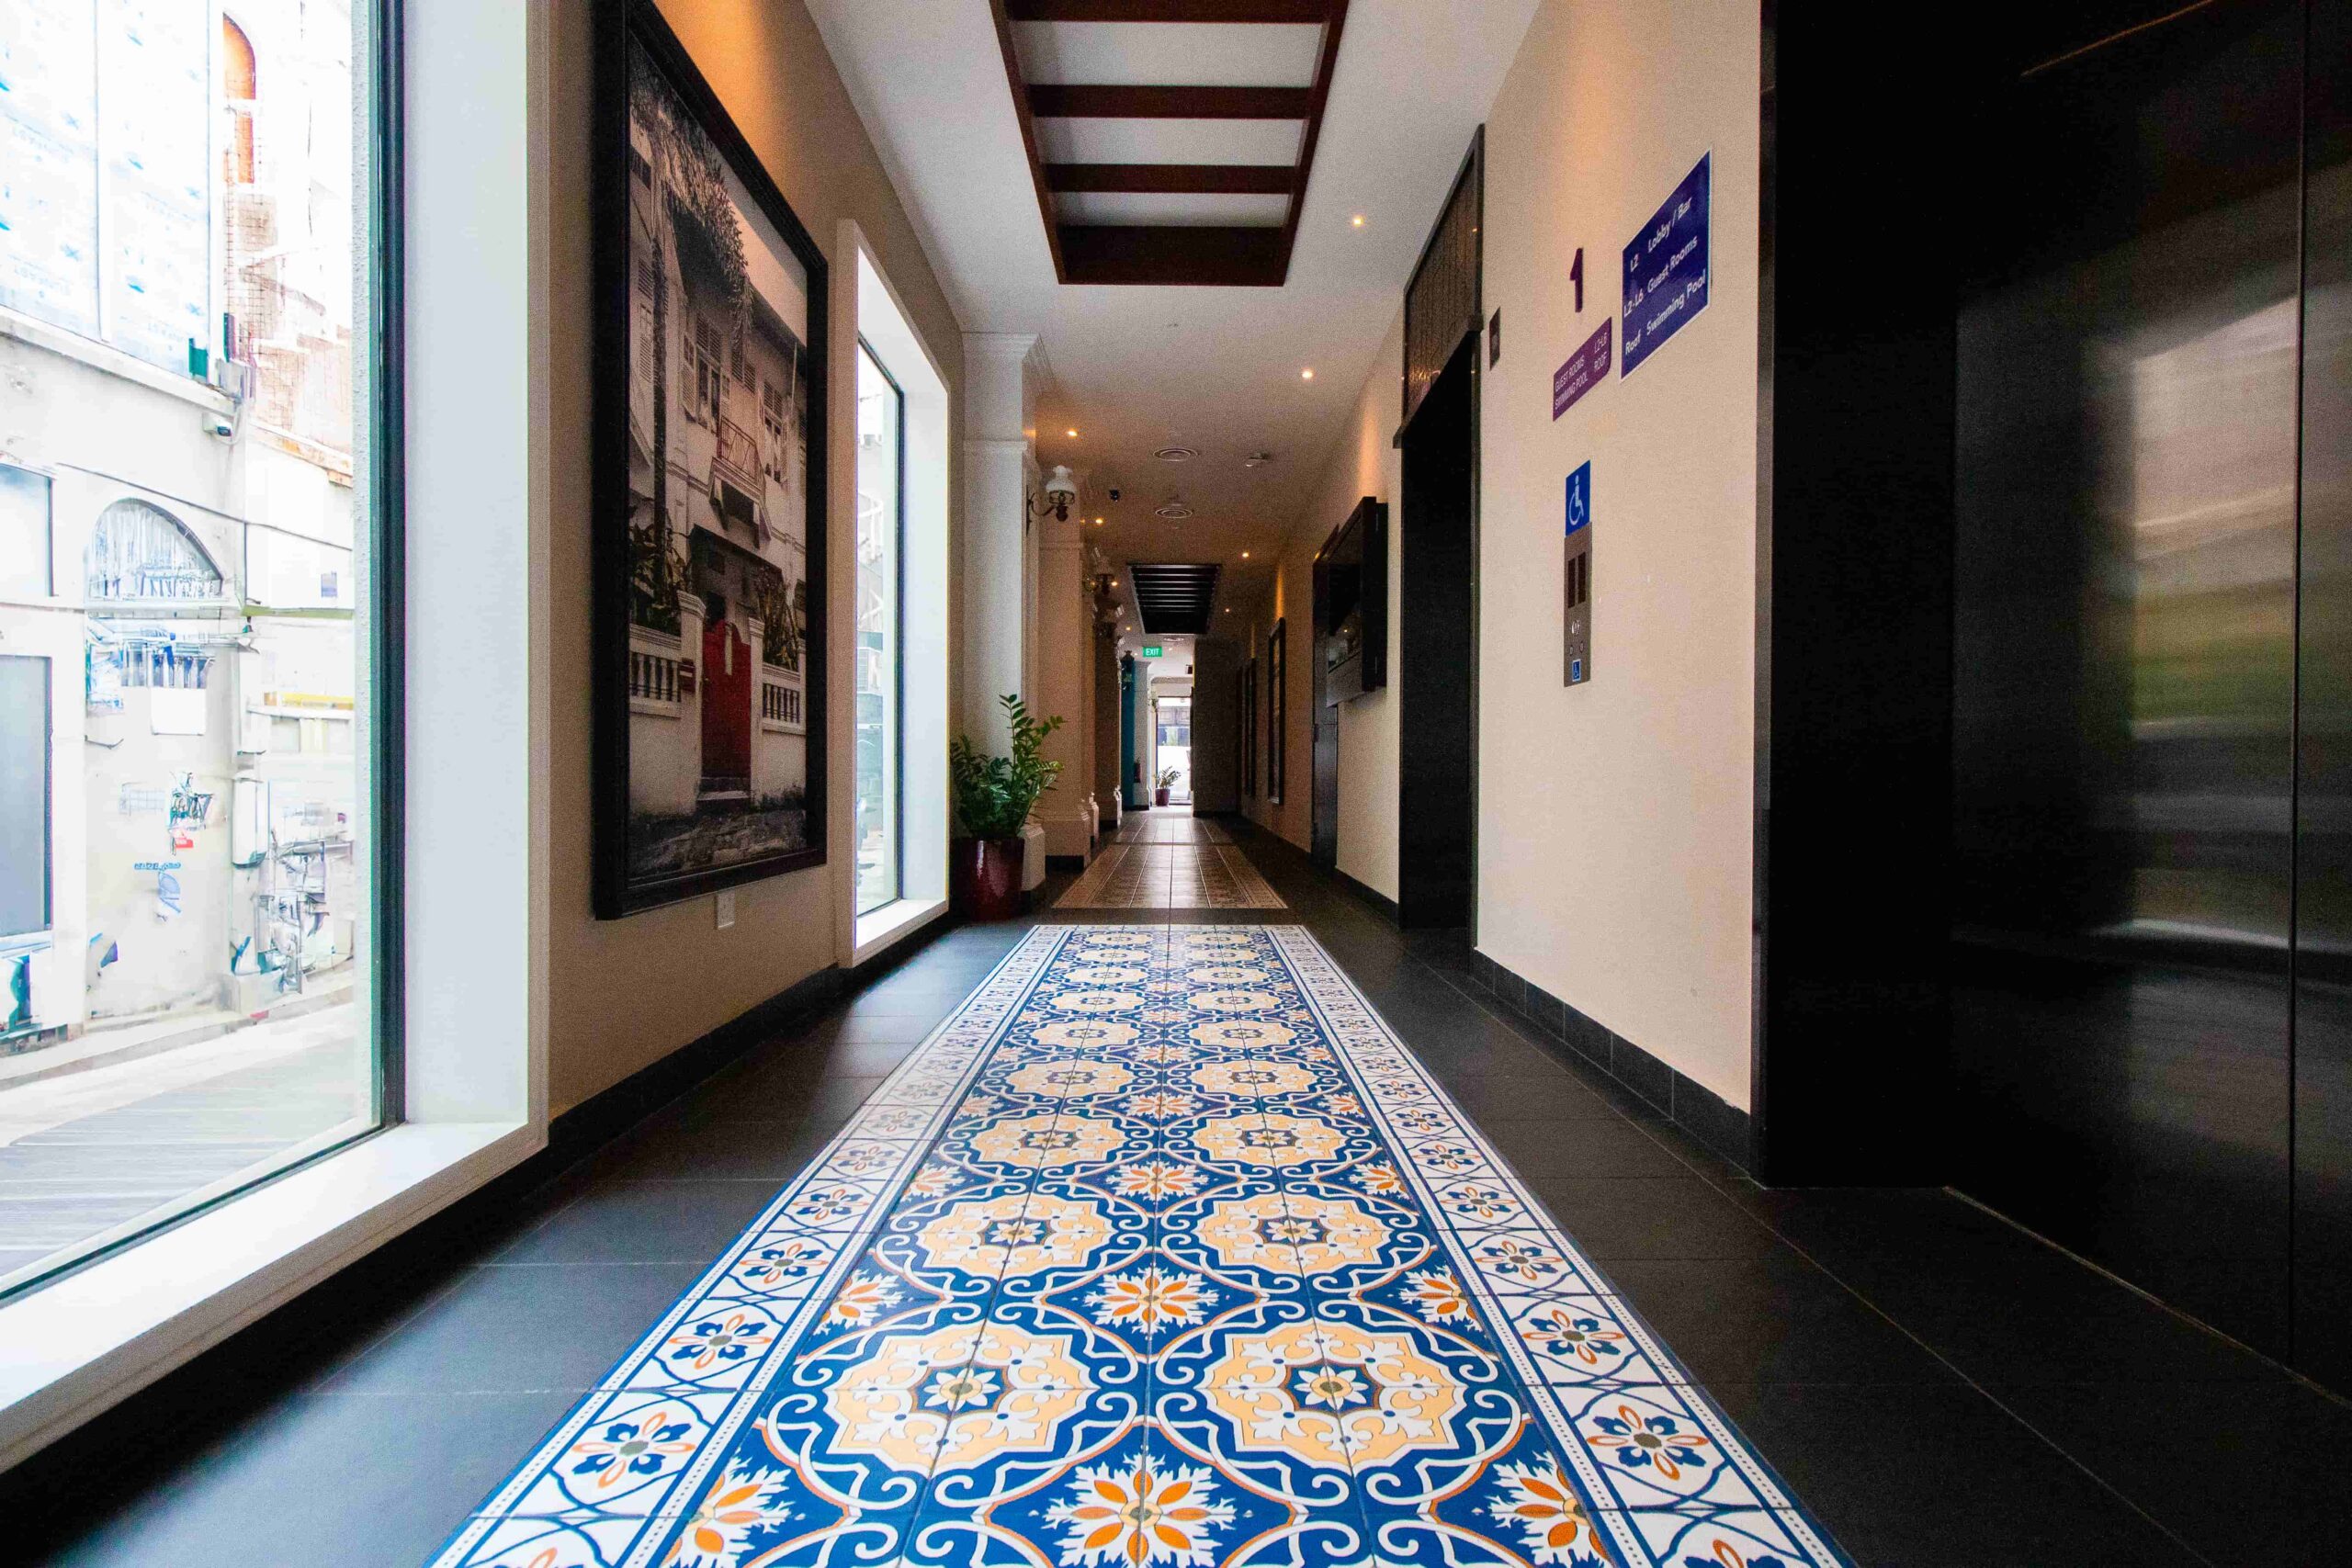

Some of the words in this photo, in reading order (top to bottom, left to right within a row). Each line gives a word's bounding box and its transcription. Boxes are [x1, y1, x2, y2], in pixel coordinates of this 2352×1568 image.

[1630, 254, 1639, 273] L2
[1647, 220, 1671, 254] Lobby
[1671, 209, 1677, 228] /
[1677, 197, 1692, 220] Bar
[1569, 247, 1583, 313] 1
[1623, 288, 1644, 319] L2-L6
[1647, 263, 1669, 293] Guest
[1669, 235, 1698, 272] Rooms
[1625, 328, 1642, 355] Roof
[1646, 293, 1685, 336] Swimming
[1686, 268, 1706, 299] Pool
[1555, 370, 1568, 392] GUEST
[1568, 355, 1585, 379] ROOMS
[1555, 382, 1576, 410] SWIMMING
[1576, 370, 1589, 391] POOL
[1593, 351, 1608, 373] ROOF
[1146, 648, 1159, 656] EXIT
